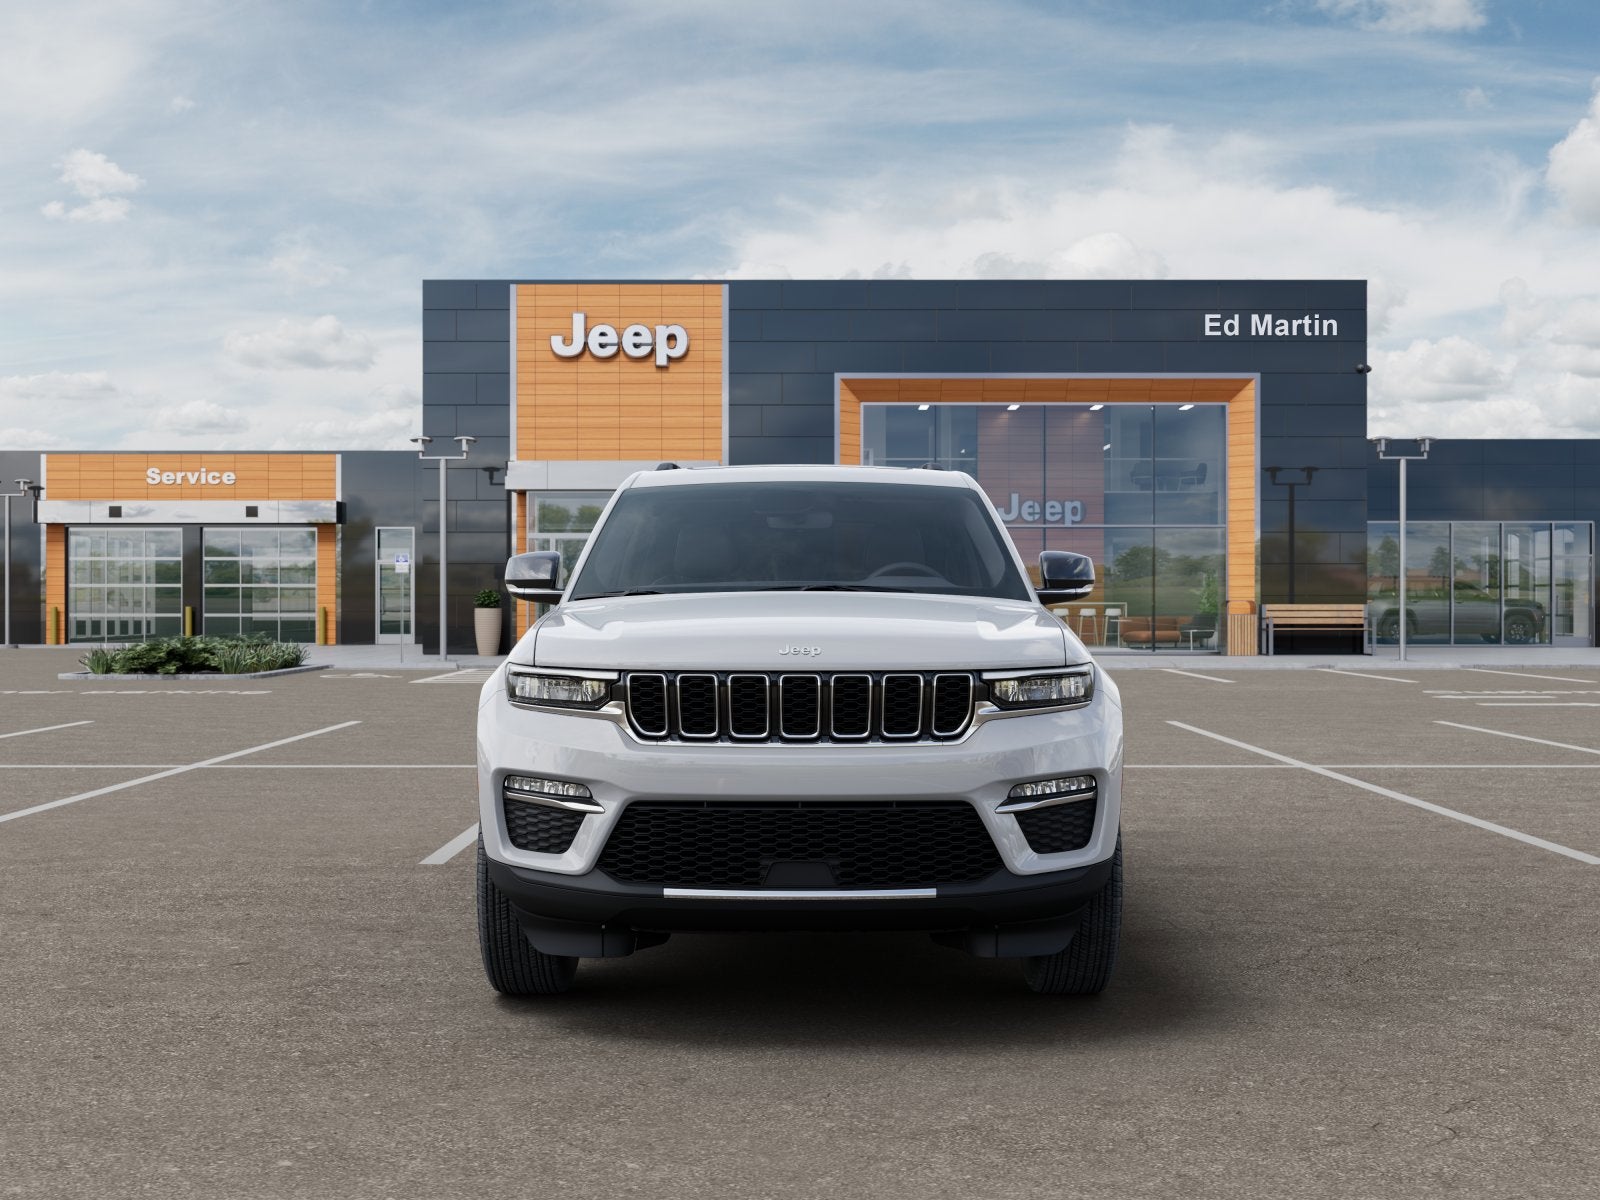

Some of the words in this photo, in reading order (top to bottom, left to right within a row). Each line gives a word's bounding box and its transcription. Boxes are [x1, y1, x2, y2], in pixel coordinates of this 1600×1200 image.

[1204, 313, 1240, 336] Ed
[1250, 313, 1338, 336] Martin
[550, 311, 689, 367] Jeep
[146, 467, 237, 486] Service
[997, 493, 1083, 527] Jeep
[778, 643, 822, 658] Jeep
